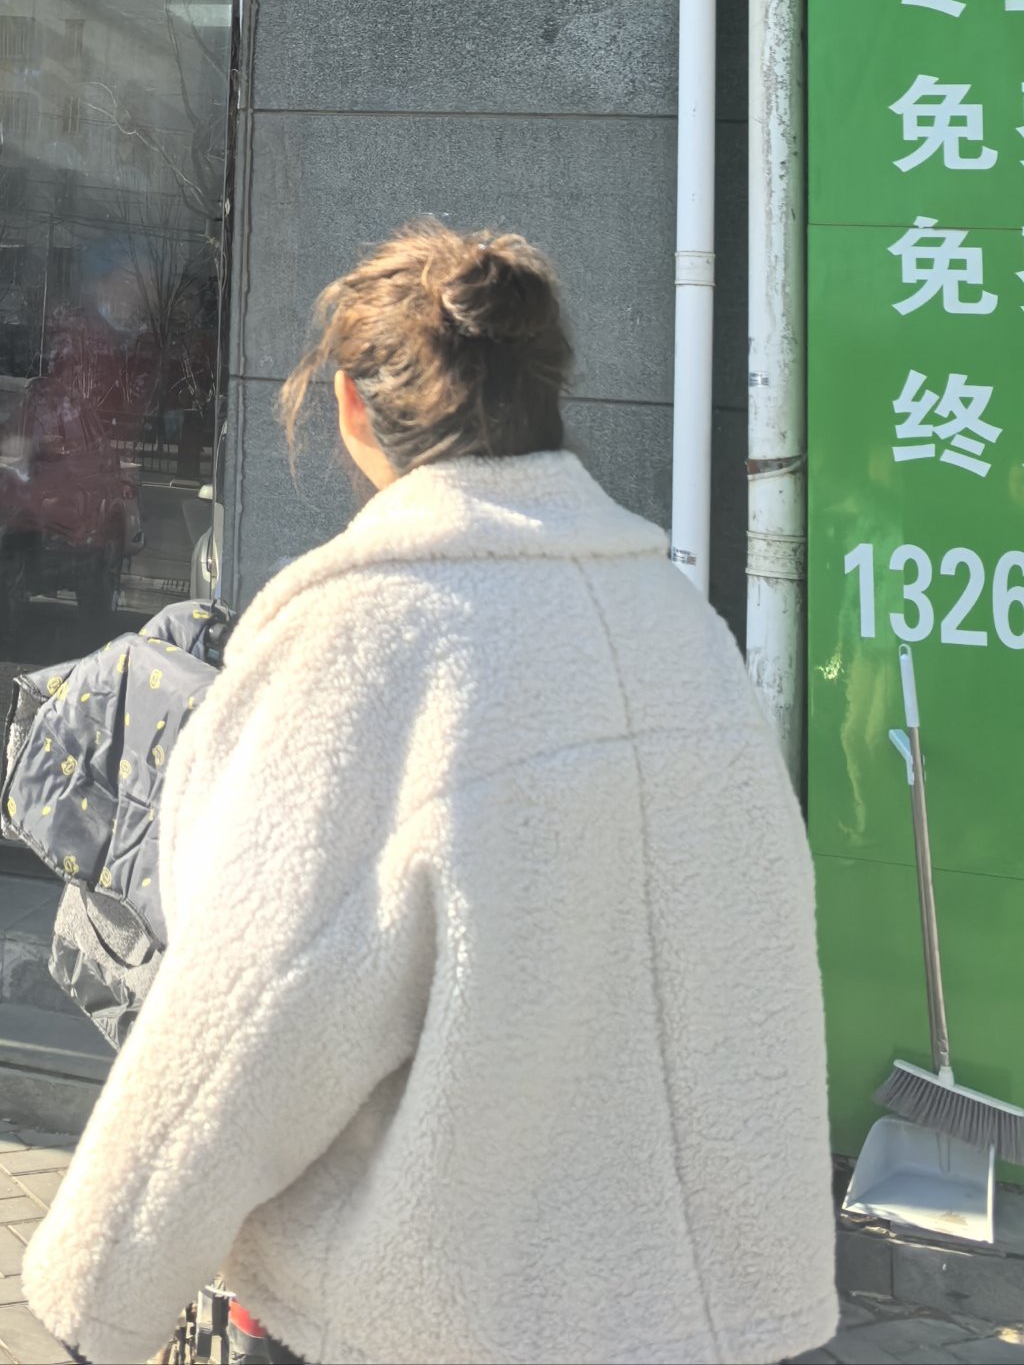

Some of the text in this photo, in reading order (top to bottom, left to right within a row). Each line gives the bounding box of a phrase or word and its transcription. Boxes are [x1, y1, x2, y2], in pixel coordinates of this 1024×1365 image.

[887, 74, 1024, 174] 免
[886, 215, 1024, 316] 免
[843, 542, 1024, 650] 1326
